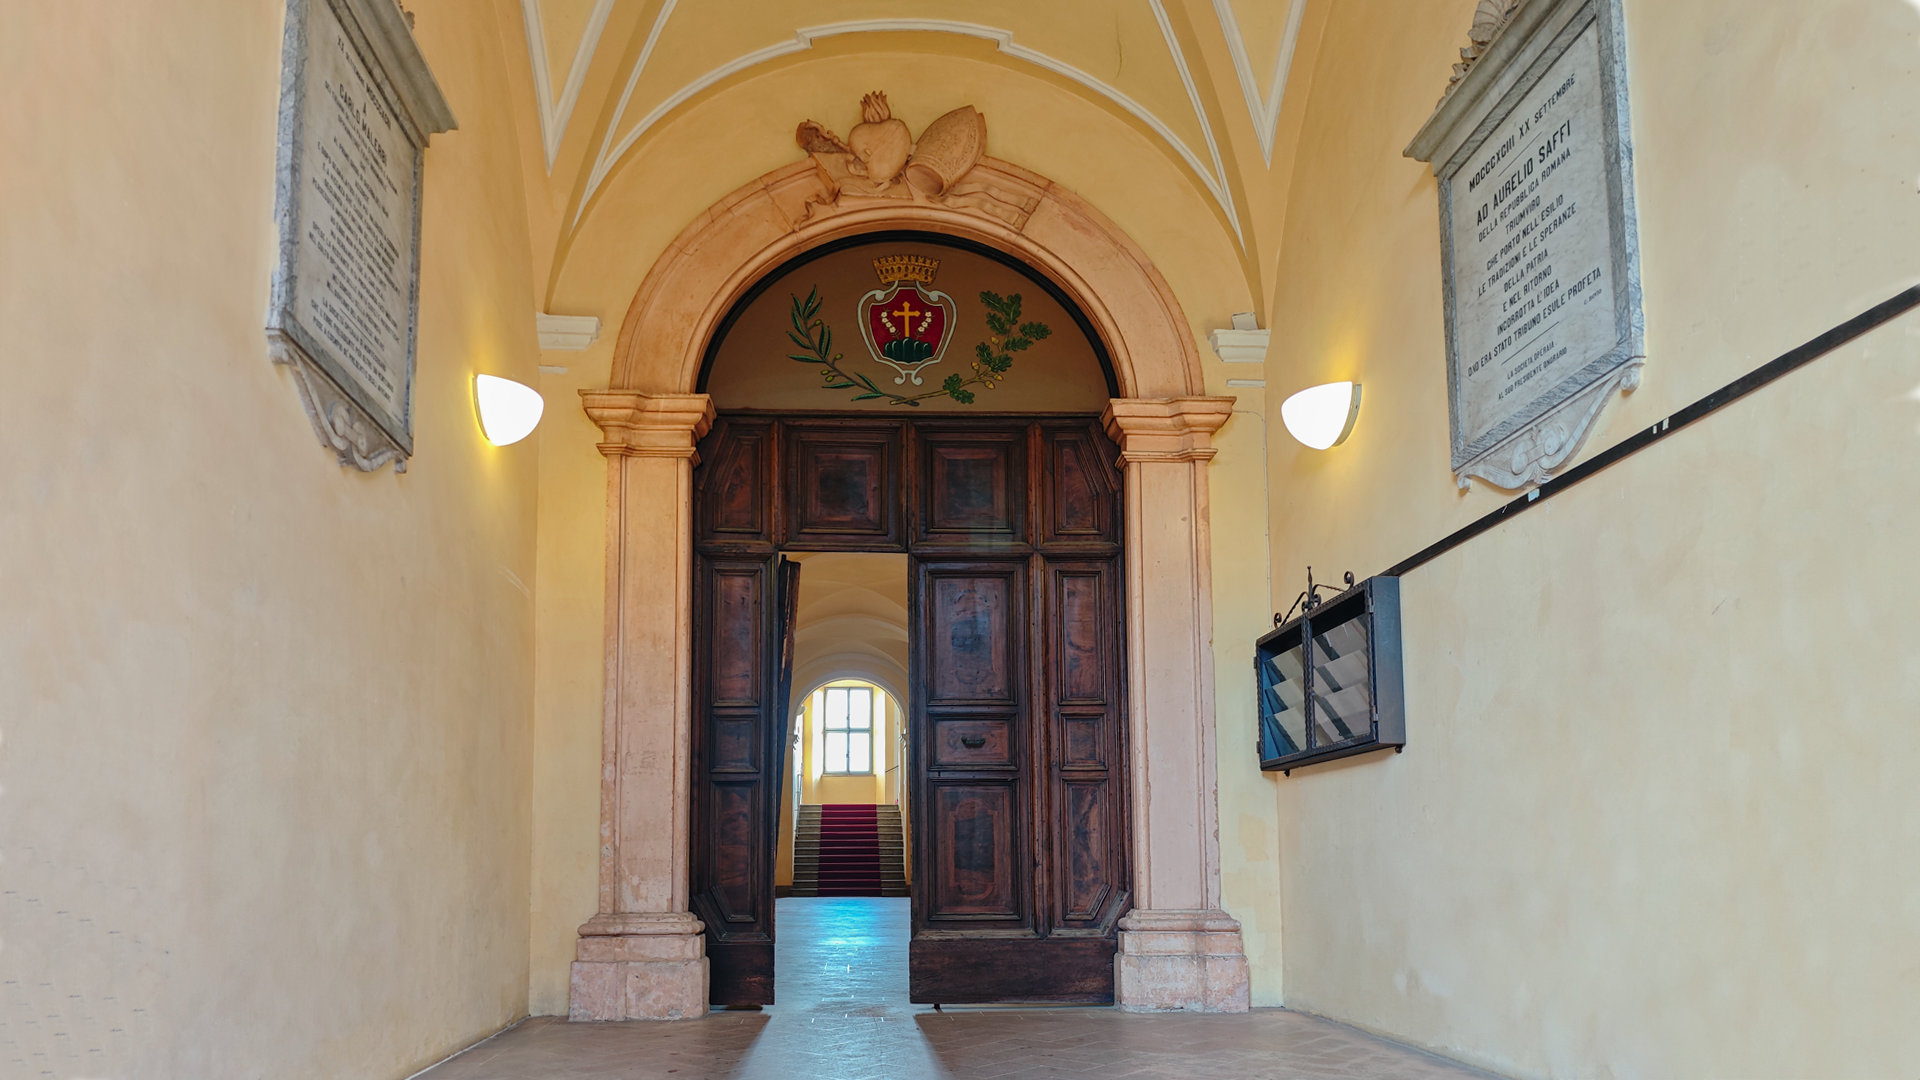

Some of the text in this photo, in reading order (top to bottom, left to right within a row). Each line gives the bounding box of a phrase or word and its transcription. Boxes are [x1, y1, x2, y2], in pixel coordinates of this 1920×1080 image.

[339, 81, 360, 126] CARLO
[1469, 72, 1575, 194] MDCCCXCIII XX SETTEMBRE
[1476, 118, 1571, 227] AD AURELIO SAFFI
[1478, 145, 1571, 244] DELLA REPUBBLICA ROMANA
[1505, 194, 1540, 236] TRIUMVIRO
[1478, 201, 1576, 298] LE TRADIZIONI E LE SPERANZE
[1486, 252, 1498, 272] CHE
[1503, 247, 1548, 294] DELLA PATRIA
[1493, 335, 1512, 358] STATO
[1513, 311, 1541, 342] TRIBUNO
[1542, 292, 1566, 320] ESULE
[1567, 264, 1601, 301] PROFETA
[1503, 263, 1552, 314] E NEL RITORNO
[1497, 297, 1535, 337] INCORROTTA
[1498, 391, 1504, 401] AL
[1504, 384, 1513, 397] SUO
[1514, 363, 1542, 390] PRESIDENTE
[1507, 370, 1513, 381] LA
